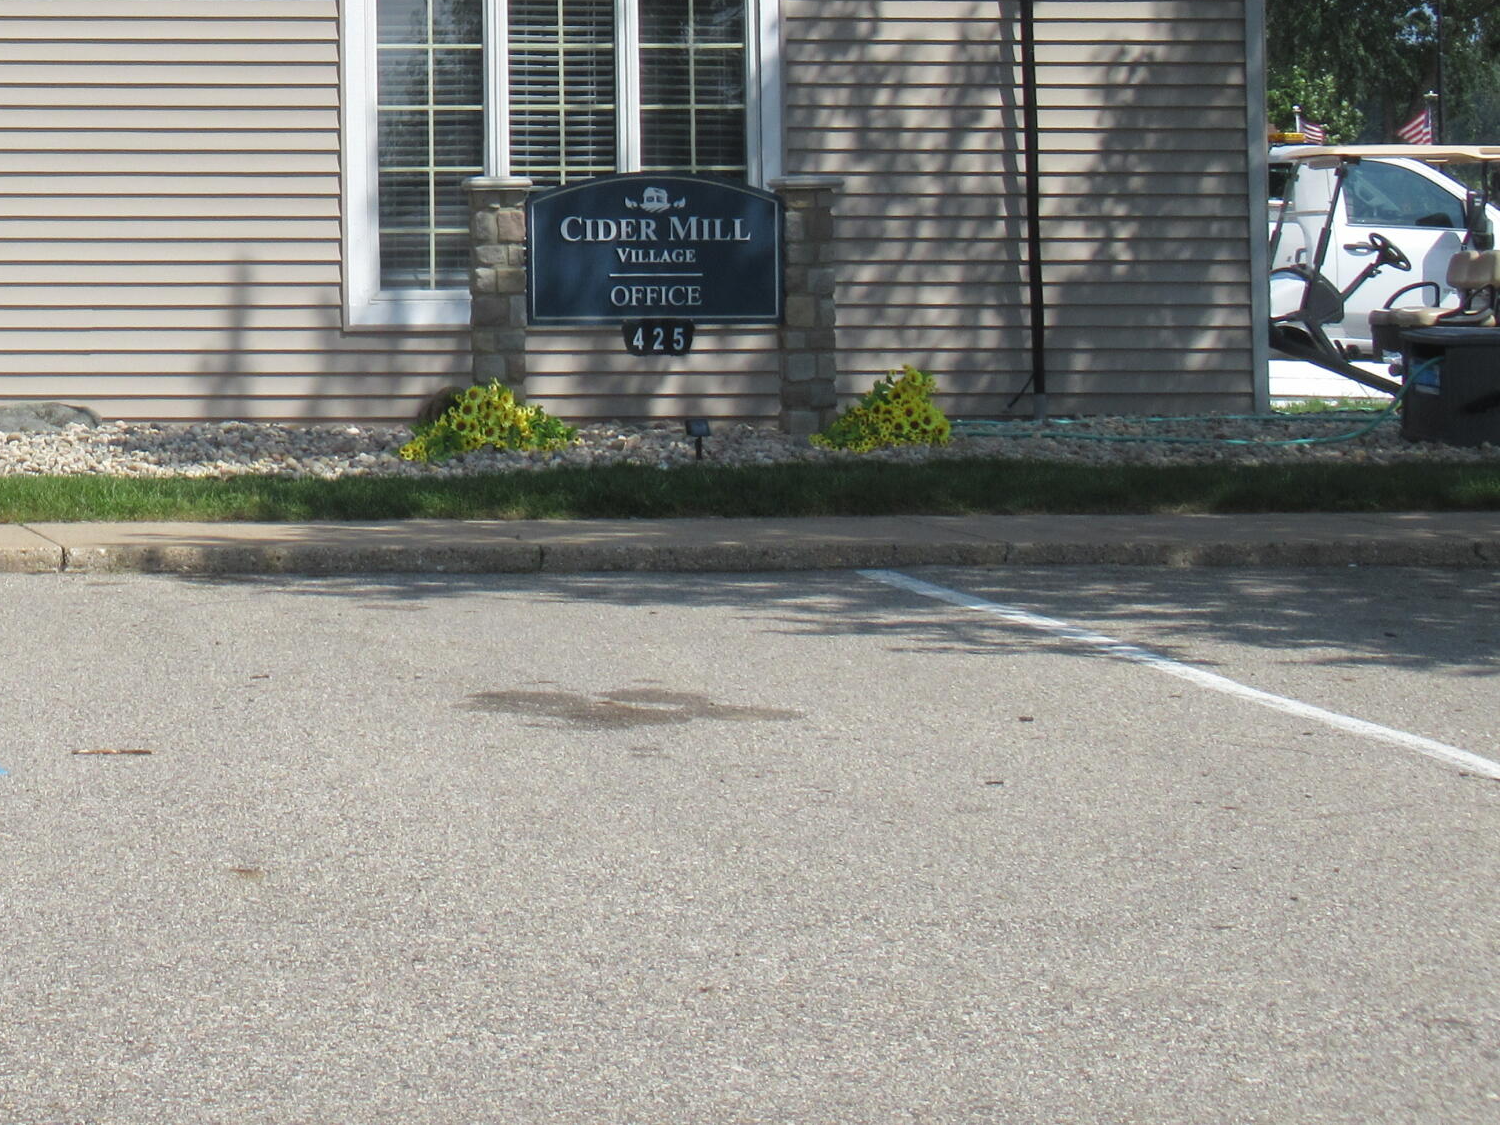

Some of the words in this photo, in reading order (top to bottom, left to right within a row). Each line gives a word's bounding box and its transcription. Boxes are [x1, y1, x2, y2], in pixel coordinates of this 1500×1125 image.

[560, 216, 658, 242] CIDER
[668, 216, 751, 241] MILL
[616, 248, 696, 263] VILLAGE
[610, 286, 702, 307] OFFICE
